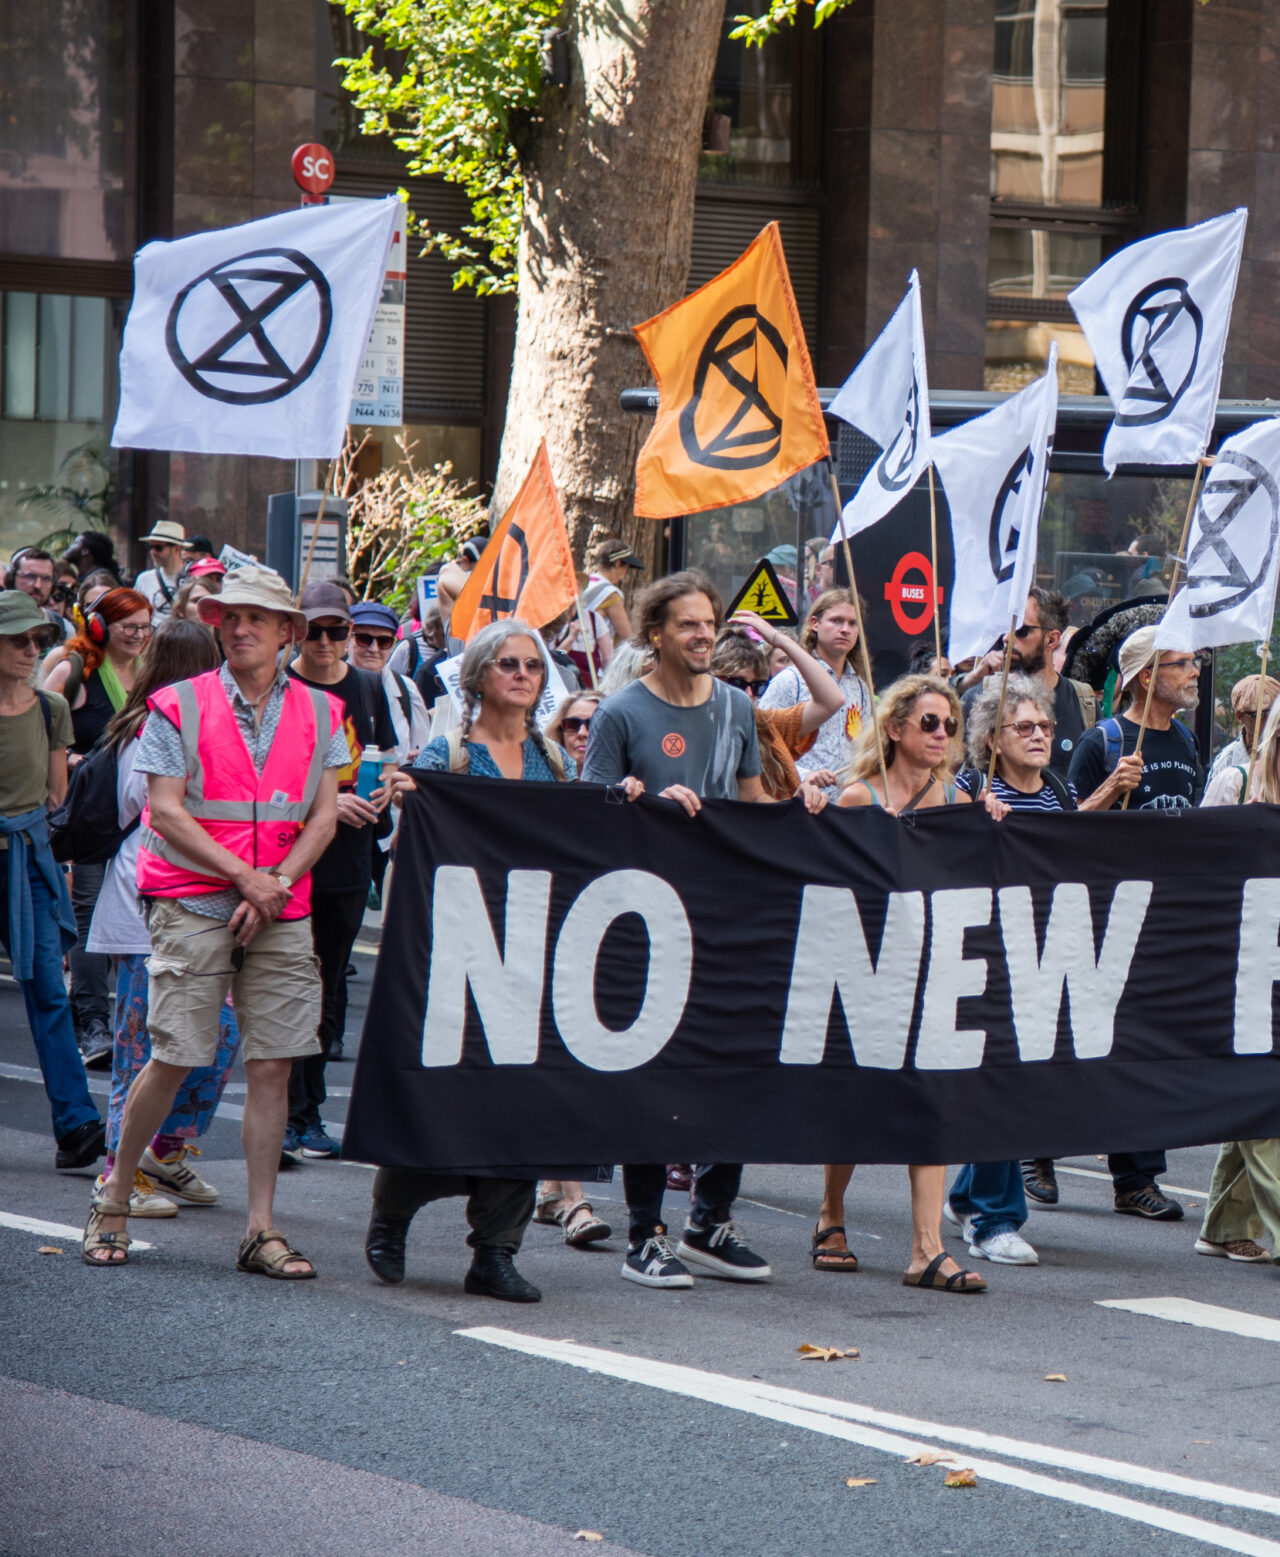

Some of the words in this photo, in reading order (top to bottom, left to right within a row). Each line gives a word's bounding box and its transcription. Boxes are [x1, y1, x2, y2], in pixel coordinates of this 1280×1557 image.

[302, 156, 329, 179] SC
[386, 336, 398, 345] 26
[357, 383, 374, 393] 770
[383, 384, 399, 393] N11
[355, 408, 374, 417] N44
[379, 409, 400, 418] N136
[902, 588, 924, 599] BUSES
[1150, 762, 1159, 771] IS
[1161, 761, 1172, 769] NO
[1174, 761, 1193, 774] PLANET
[422, 865, 693, 1071] NO
[779, 880, 1154, 1070] NEW
